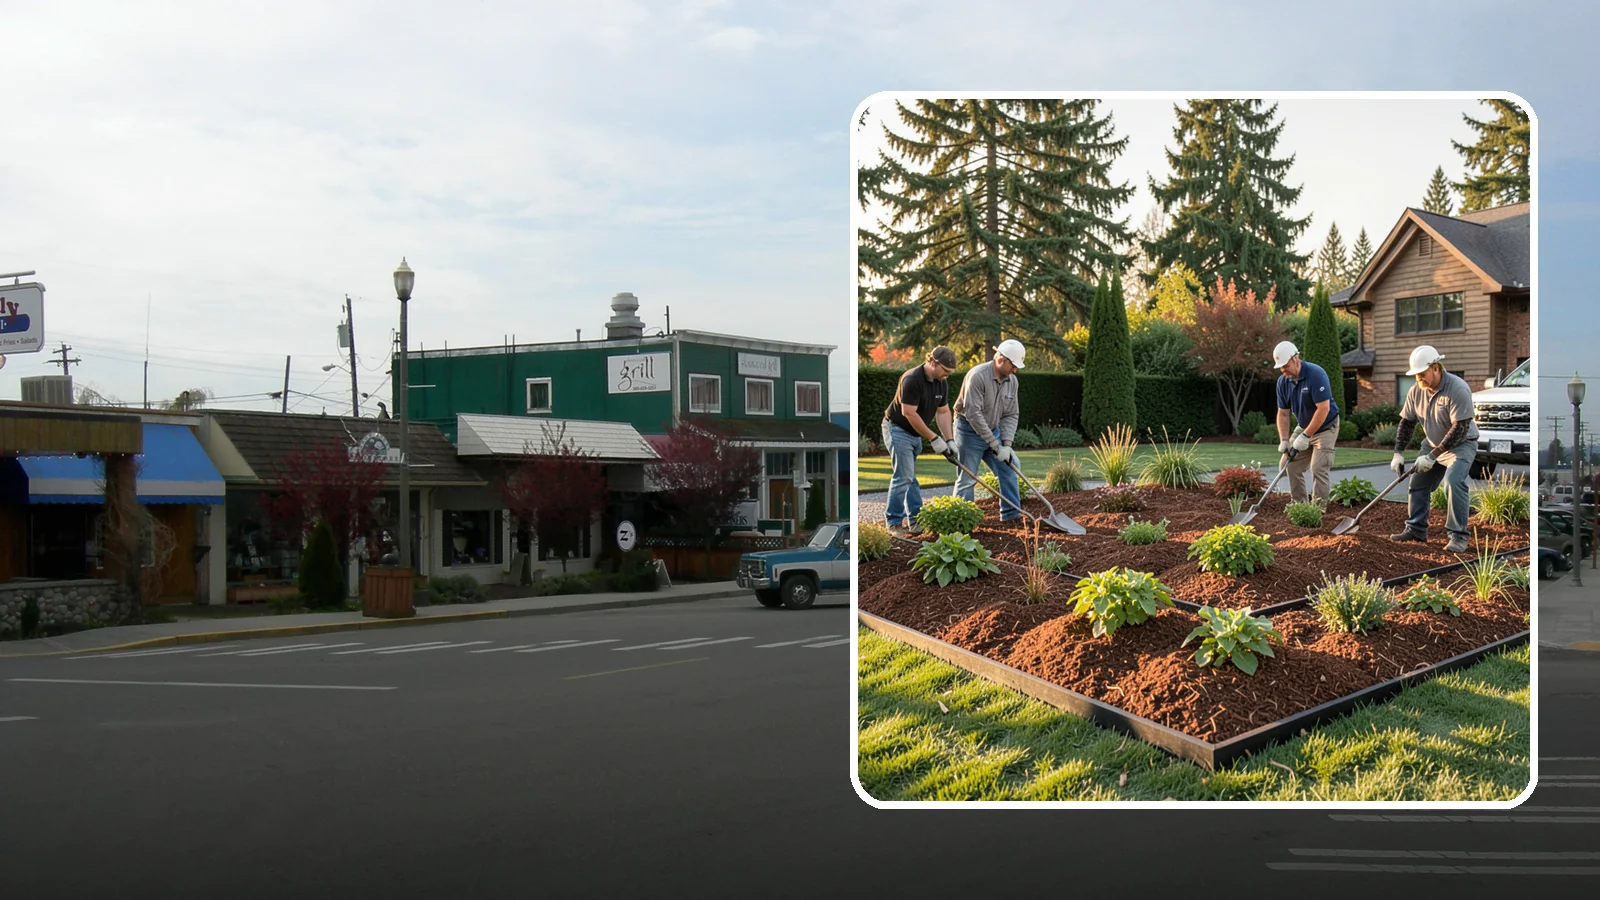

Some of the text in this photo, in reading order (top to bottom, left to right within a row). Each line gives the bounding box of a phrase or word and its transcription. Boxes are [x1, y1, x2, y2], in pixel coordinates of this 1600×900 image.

[3, 338, 15, 346] Fries
[21, 337, 38, 345] Salads
[618, 356, 654, 391] grill
